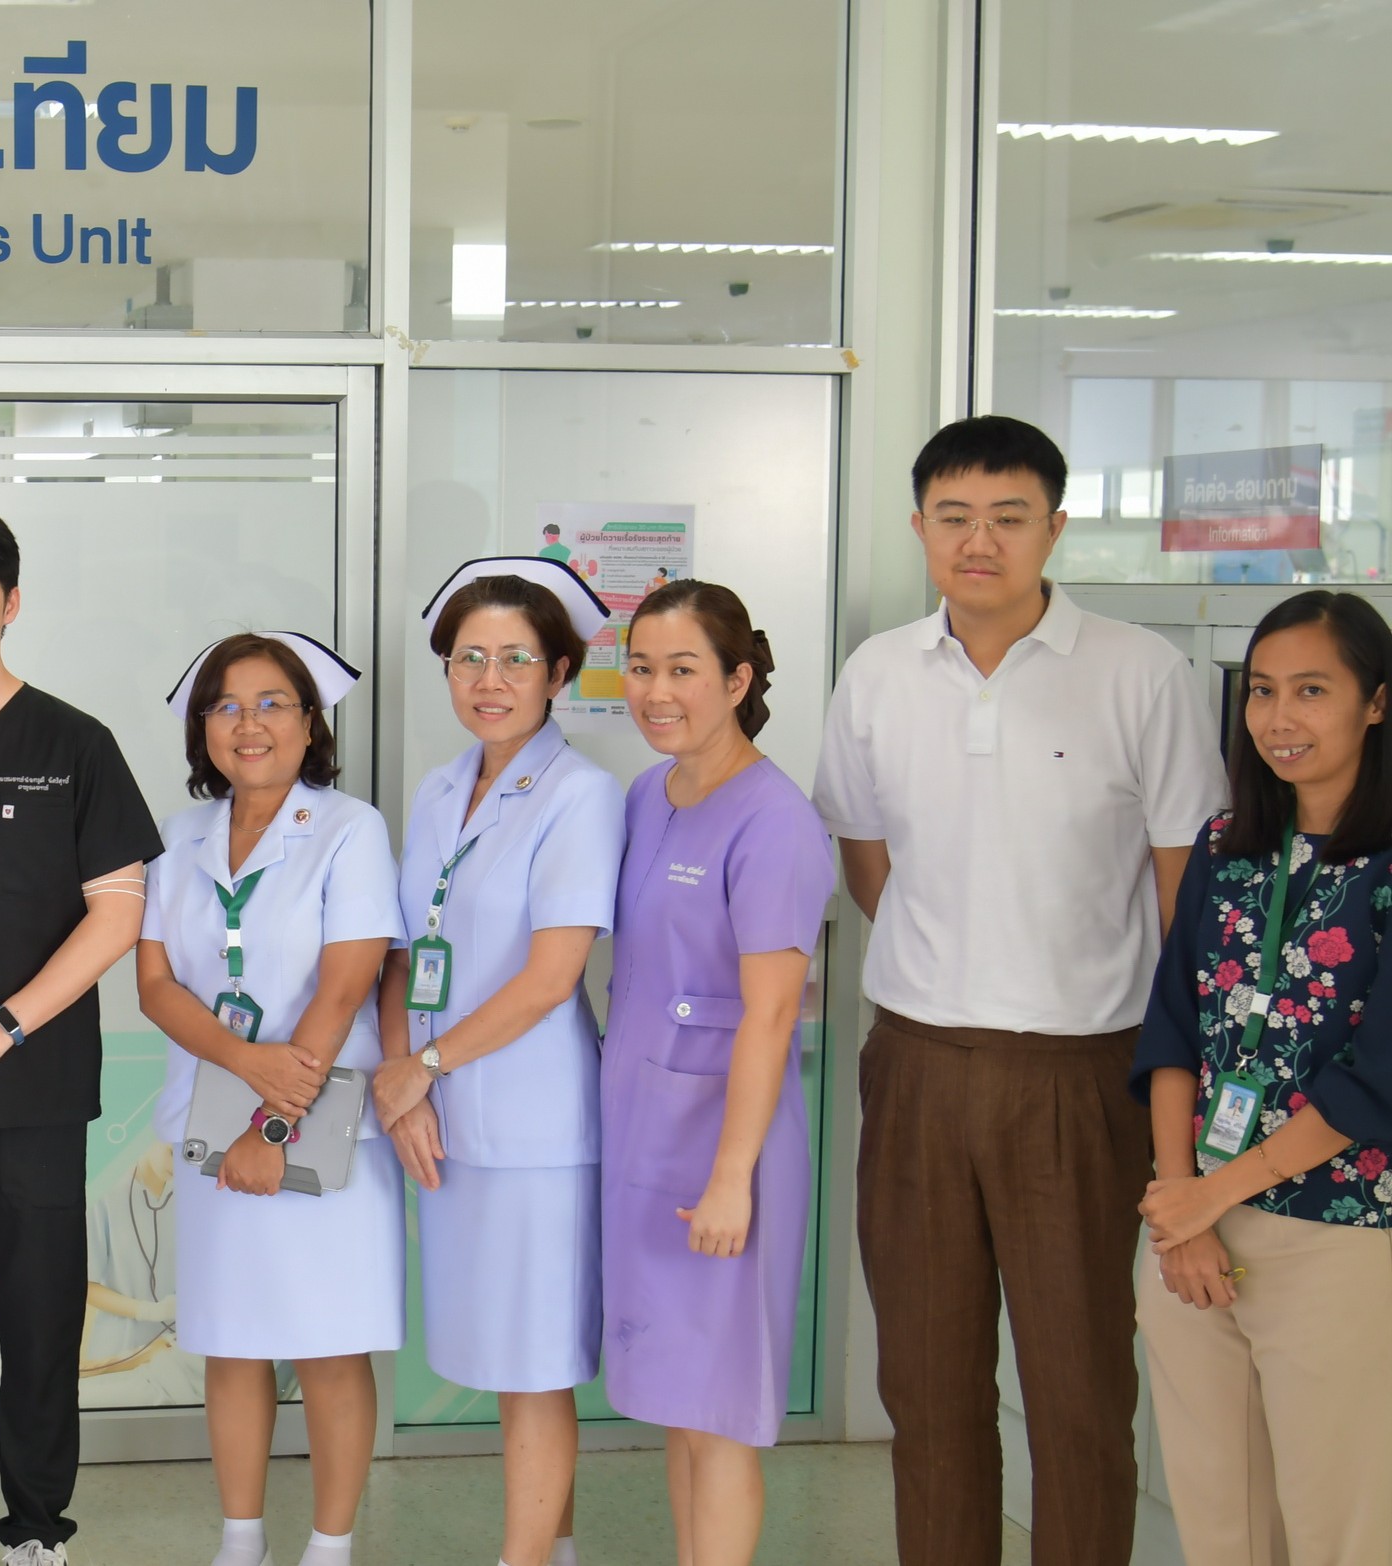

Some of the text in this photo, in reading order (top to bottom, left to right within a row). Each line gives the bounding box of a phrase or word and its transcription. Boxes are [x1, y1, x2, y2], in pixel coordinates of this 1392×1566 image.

[1184, 474, 1297, 504] ติดต่อ-สอบถาม
[1209, 527, 1268, 543] Information
